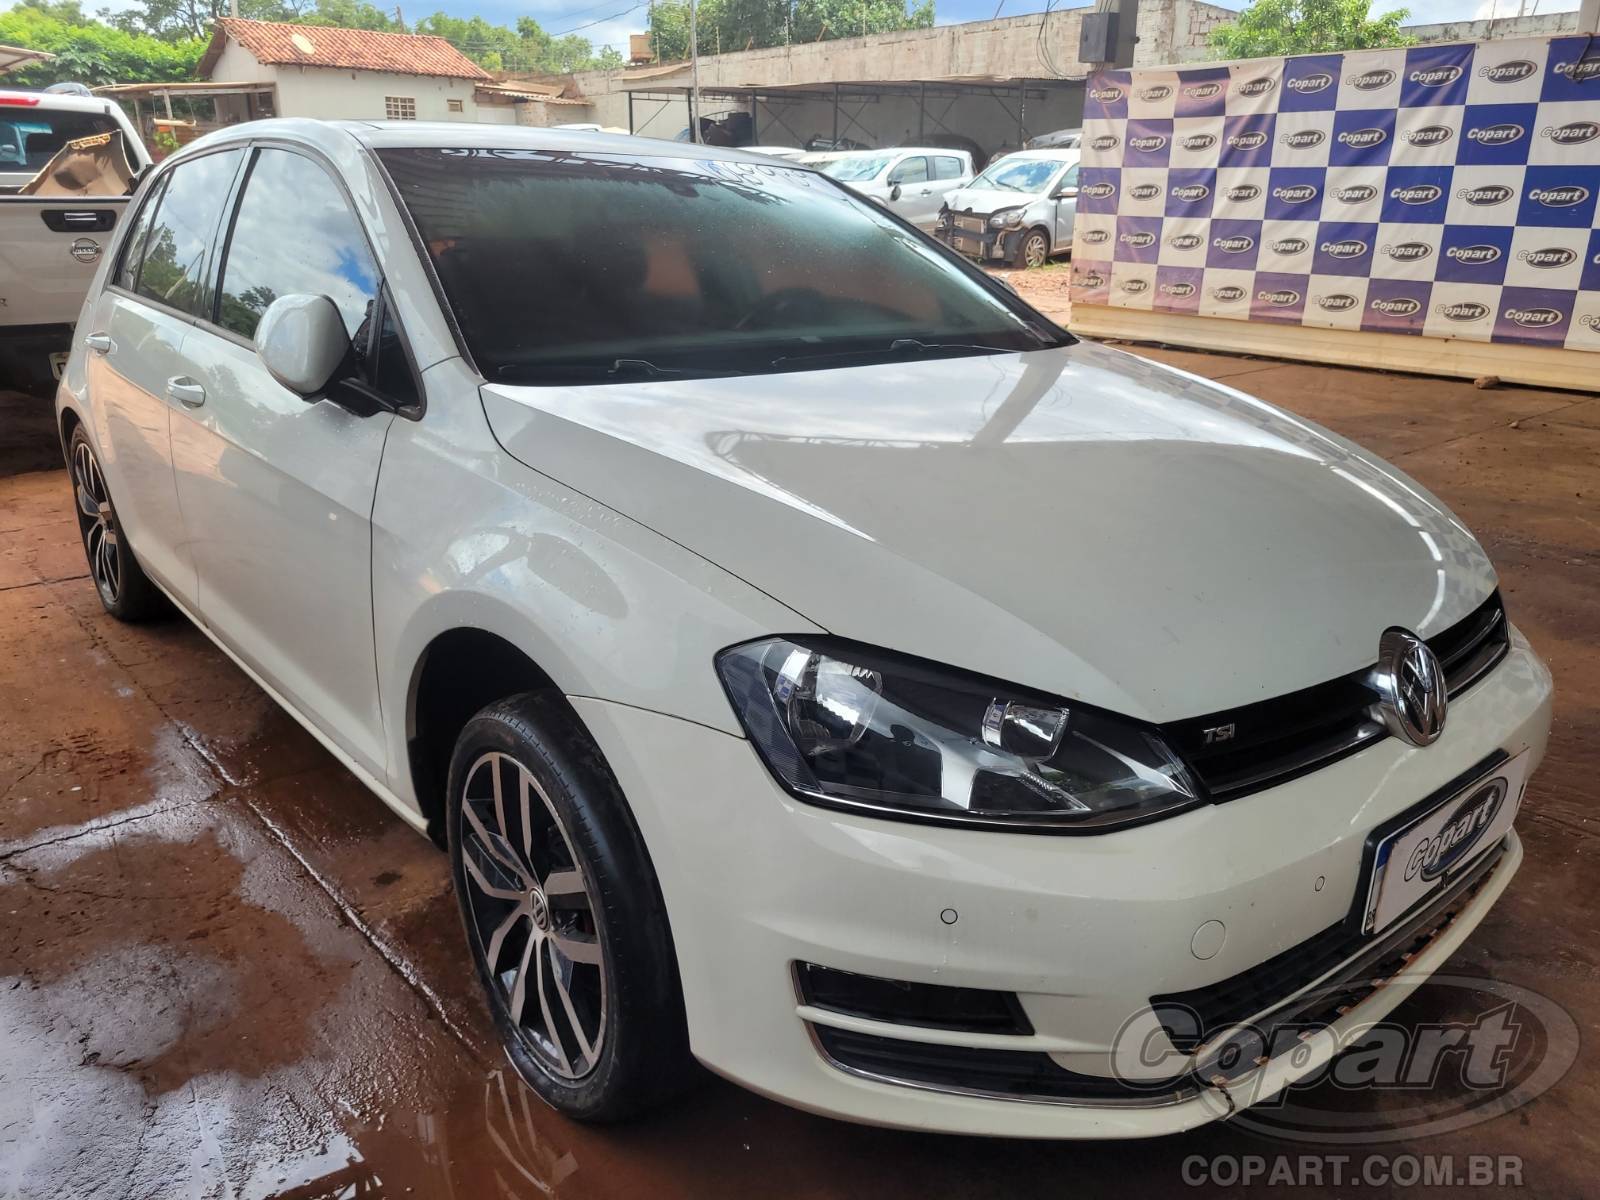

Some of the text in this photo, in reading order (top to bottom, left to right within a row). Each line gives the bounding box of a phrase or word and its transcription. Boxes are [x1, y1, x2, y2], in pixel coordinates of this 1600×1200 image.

[1409, 67, 1457, 82] Copart
[1479, 62, 1527, 79] Copart
[1287, 76, 1327, 91] Copart
[1346, 73, 1388, 89] Copart
[1090, 88, 1119, 100] Copart
[1184, 84, 1218, 97] Copart
[1227, 132, 1263, 146] Copart
[1280, 130, 1319, 146] Copart
[1338, 129, 1381, 144] Copart
[1402, 128, 1447, 143] Copart
[1467, 126, 1517, 141] Copart
[1541, 125, 1593, 141] Copart
[1130, 136, 1162, 148] Copart
[1081, 184, 1110, 196] Copart
[1172, 187, 1204, 198] Copart
[1272, 186, 1311, 200] Copart
[1331, 186, 1372, 200] Copart
[1391, 186, 1436, 201] Copart
[1457, 186, 1507, 202] Copart
[1528, 187, 1583, 203] Copart
[1119, 234, 1151, 246] Copart
[1213, 238, 1248, 250] Copart
[1321, 241, 1361, 256] Copart
[1381, 243, 1426, 258] Copart
[1447, 246, 1495, 262] Copart
[1517, 249, 1569, 265] Copart
[1117, 279, 1146, 291] opart
[1160, 284, 1191, 297] Copart
[1258, 290, 1294, 305] Copart
[1371, 298, 1413, 315] Copart
[1435, 304, 1481, 320] Copart
[1505, 309, 1555, 326] Copart
[1203, 722, 1236, 744] TSI
[1404, 787, 1498, 882] Copart
